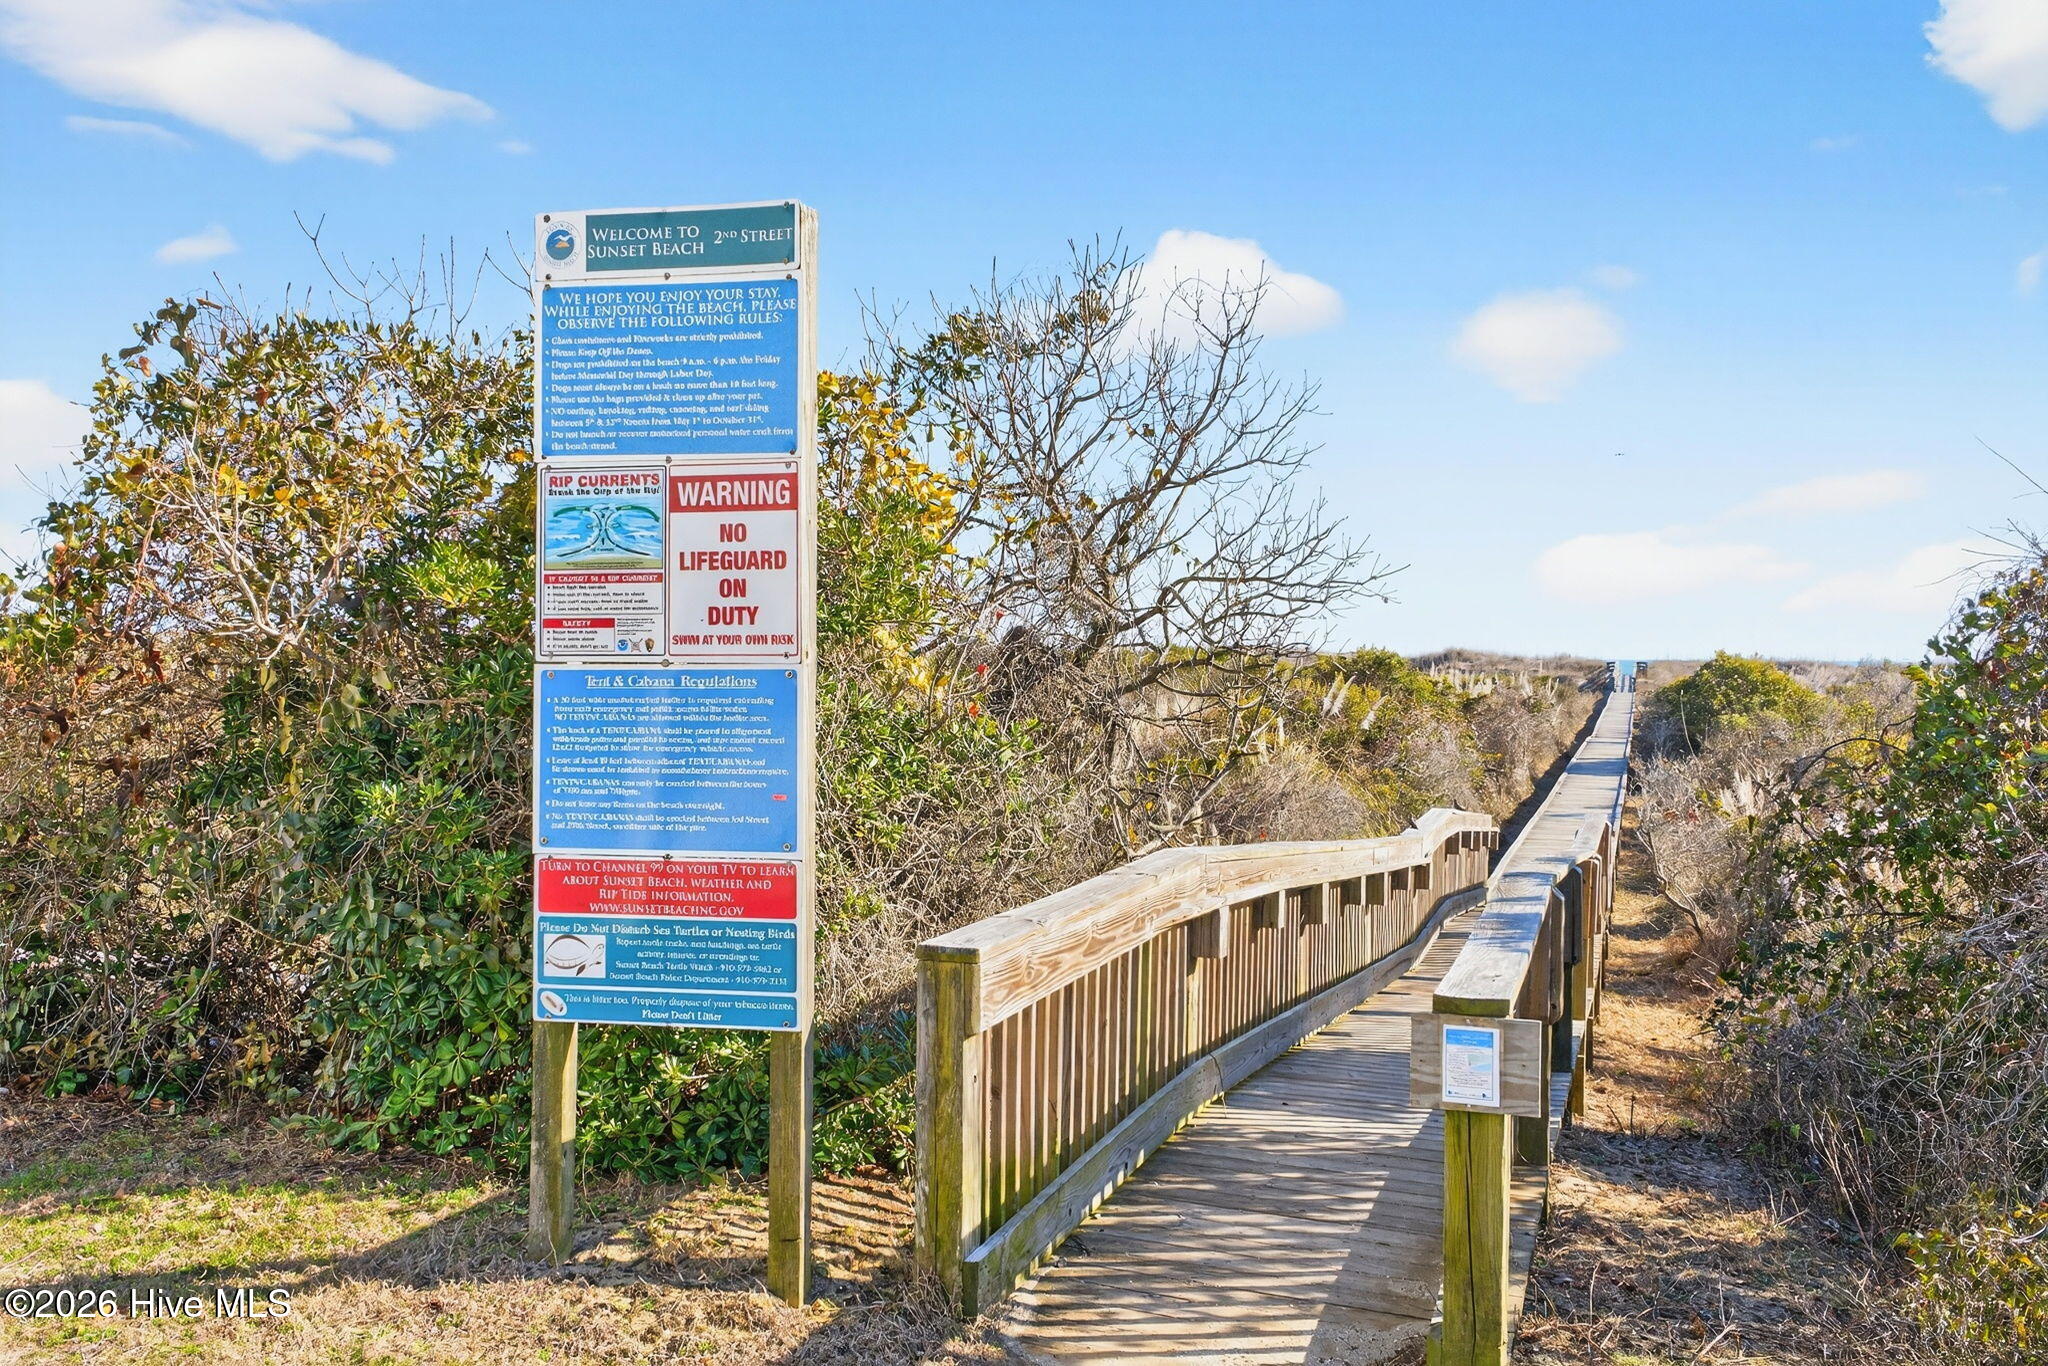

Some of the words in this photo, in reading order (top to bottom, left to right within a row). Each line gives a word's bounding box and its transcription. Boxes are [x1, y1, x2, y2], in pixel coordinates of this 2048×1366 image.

[592, 226, 673, 242] WELCOME
[676, 225, 700, 239] TO
[740, 227, 793, 243] STREET
[587, 244, 647, 259] SUNSET
[652, 241, 705, 256] BEACH
[560, 293, 581, 305] WE
[586, 292, 623, 304] HOPE
[625, 291, 655, 304] YOU
[660, 289, 703, 304] ENJOY
[705, 288, 744, 301] YOUR
[544, 305, 591, 318] WHILE
[594, 303, 663, 320] ENJOYING
[666, 302, 695, 315] THE
[751, 298, 797, 312] PLEASE
[557, 318, 616, 330] OBSERVE
[618, 316, 648, 329] THE
[650, 313, 734, 328] FOLLOWING
[739, 311, 784, 325] RULES:
[549, 475, 574, 488] RIP
[577, 473, 661, 488] CURRENTS
[677, 479, 791, 507] WARNING
[719, 523, 748, 543] NO
[679, 549, 788, 572] LIFEGUARD
[719, 578, 747, 598] ON
[707, 605, 760, 626] DUTY
[672, 634, 700, 646] SWIM
[702, 634, 715, 646] AT
[715, 634, 743, 646] YOUR
[745, 634, 768, 646] OWN
[770, 633, 795, 645] RISK
[584, 675, 611, 688] Tent
[613, 675, 624, 687] &
[627, 674, 675, 688] Cabana
[680, 674, 759, 689] Regulations
[540, 859, 572, 872] TURN
[574, 861, 591, 872] TO
[592, 861, 648, 874] CHANNEL
[666, 864, 685, 874] ON
[687, 864, 720, 875] YOUR
[720, 864, 738, 876] TV
[739, 864, 757, 876] TO
[759, 866, 796, 877] LEARN
[562, 875, 600, 886] ABOUT
[602, 875, 645, 887] SUNSET
[690, 878, 745, 890] WEATHER
[746, 879, 773, 890] AND
[599, 888, 619, 900] RIP
[621, 888, 647, 900] TIDE
[540, 921, 571, 933] Please
[573, 922, 588, 933] Do
[590, 923, 610, 934] Not
[611, 923, 652, 935] Disturb
[653, 925, 671, 935] Sea
[672, 925, 710, 937] Turtles
[711, 928, 724, 937] or
[725, 926, 766, 941] Nesting
[767, 928, 796, 940] Birds
